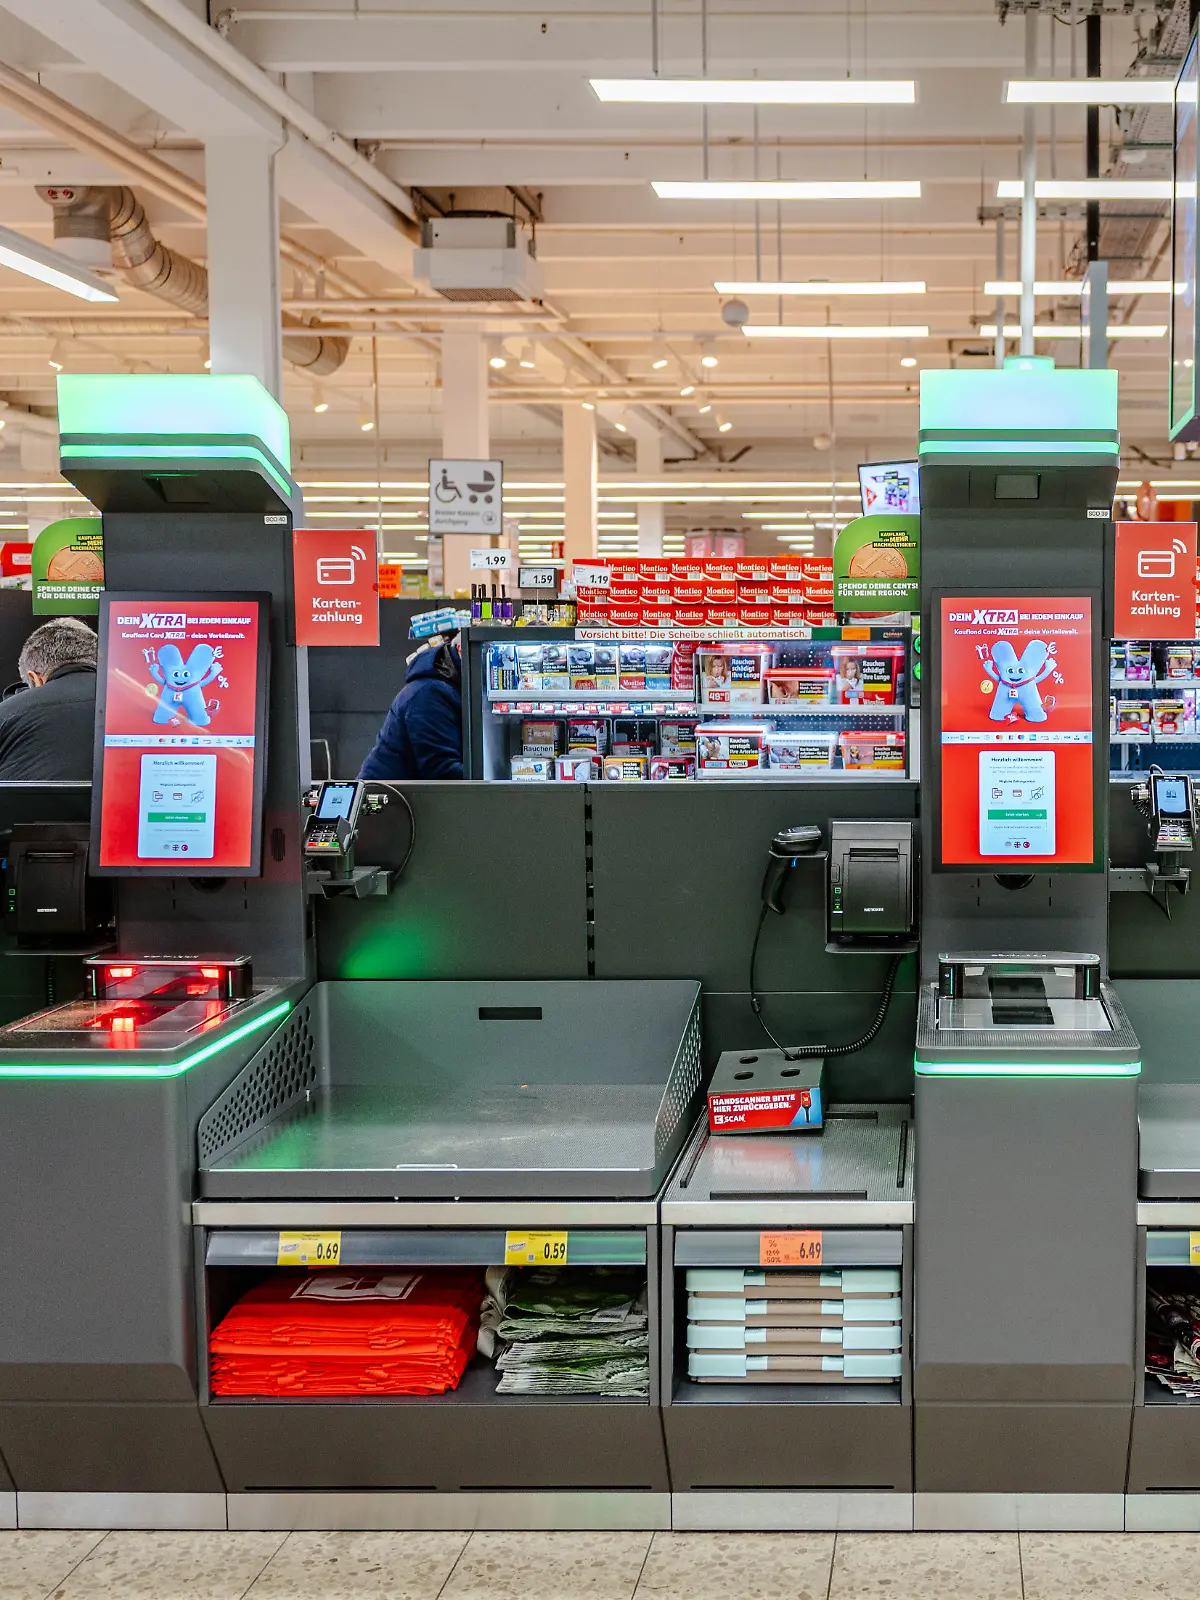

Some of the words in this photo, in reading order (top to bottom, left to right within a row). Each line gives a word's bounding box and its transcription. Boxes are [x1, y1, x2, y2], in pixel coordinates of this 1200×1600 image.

[486, 556, 506, 564] 1.99
[640, 564, 668, 572] Montico
[672, 563, 700, 571] Montico
[737, 562, 765, 571] Montico
[771, 562, 799, 571] Montico
[804, 563, 832, 571] Montico
[534, 575, 552, 584] 1.59
[590, 575, 608, 584] 1.19
[1132, 590, 1180, 601] Karten-
[312, 597, 362, 608] Karten-
[1130, 604, 1180, 618] zahlung
[139, 614, 186, 628] XTRA
[312, 611, 362, 624] zahlung
[949, 613, 972, 621] DEIN
[971, 610, 1018, 624] XTRA
[580, 630, 619, 639] Vorsicht
[622, 630, 647, 639] bitte!
[668, 630, 704, 639] Scheibe
[707, 630, 743, 639] schließt
[746, 630, 808, 638] automatisch.
[712, 1096, 771, 1105] HANDSCANNER
[772, 1094, 795, 1102] BITTE
[733, 1102, 792, 1112] ZURÜCKGEBEN.
[317, 1243, 338, 1259] 0.69
[544, 1242, 566, 1259] 0.59
[800, 1243, 821, 1259] 6.49
